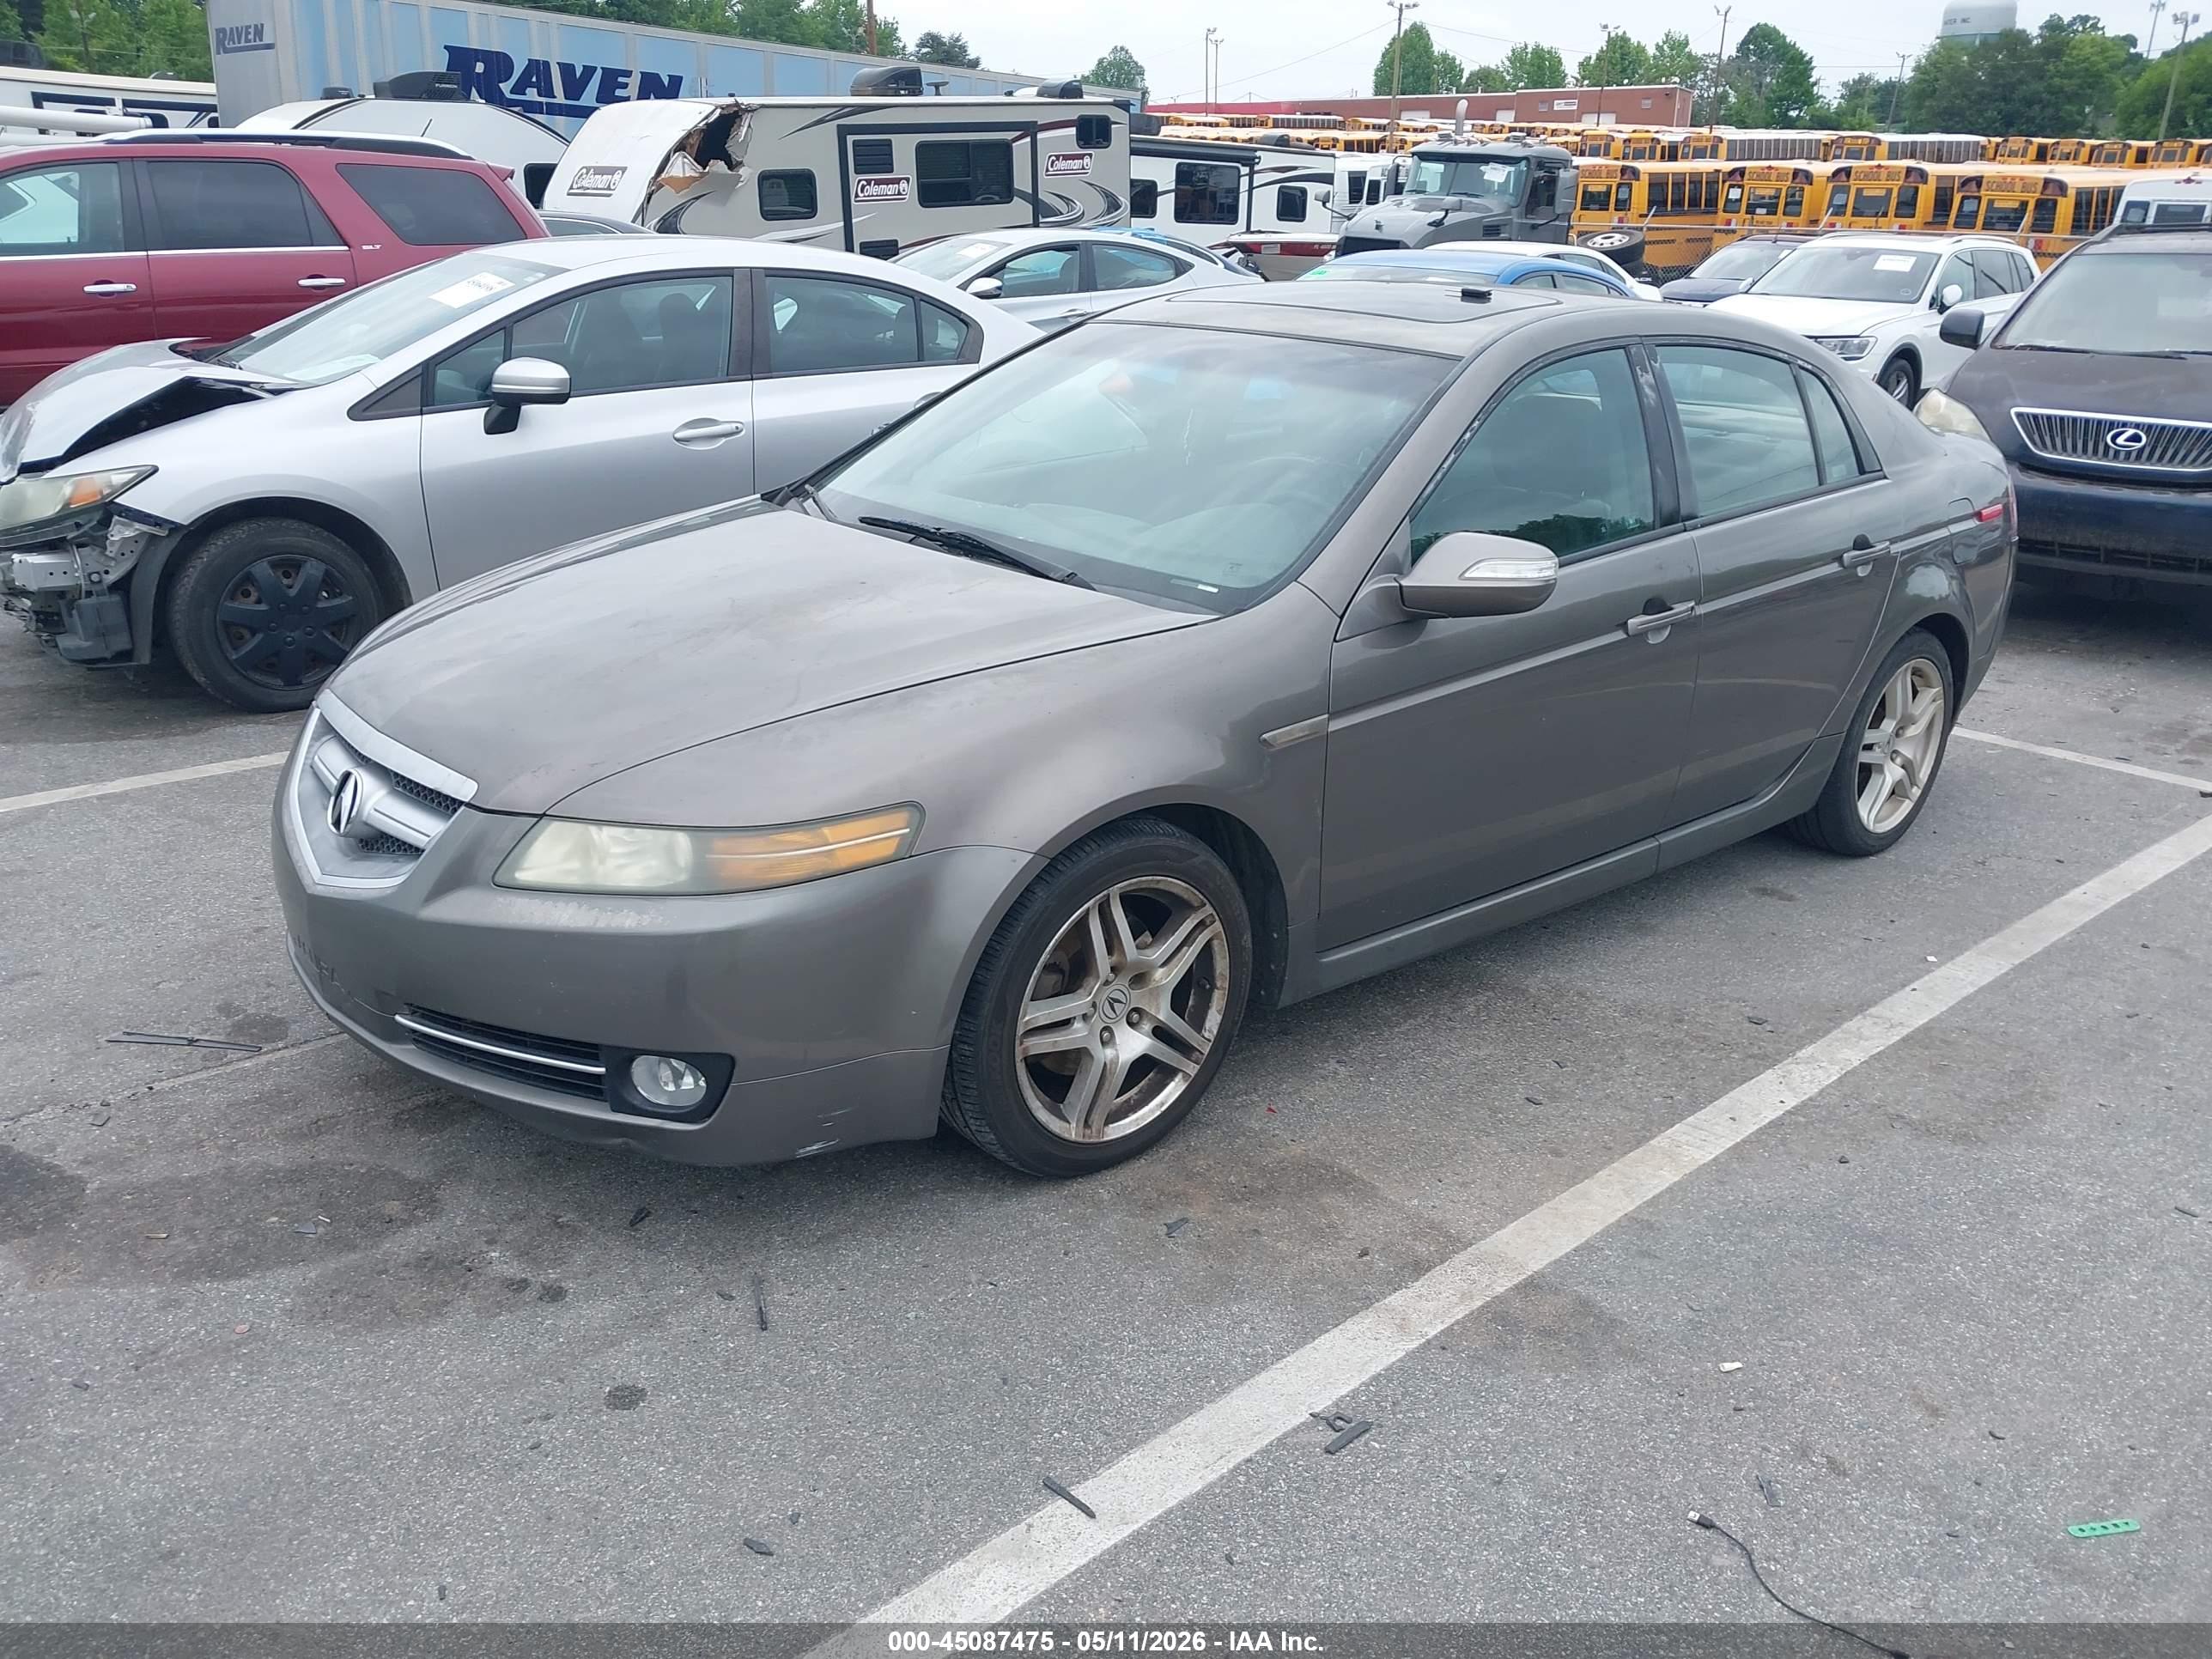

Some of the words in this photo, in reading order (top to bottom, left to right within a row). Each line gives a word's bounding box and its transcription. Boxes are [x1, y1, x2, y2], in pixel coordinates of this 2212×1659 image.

[215, 22, 264, 55] RAVEN
[443, 45, 684, 108] RAVEN
[1048, 155, 1083, 171] Coleman
[573, 167, 613, 189] Coleman
[1747, 171, 1772, 181] SCHOOL
[1777, 172, 1789, 182] BUS
[1854, 170, 1881, 181] SCHOOL
[1886, 171, 1901, 181] BUS
[857, 179, 899, 197] Coleman
[1986, 180, 2015, 192] SCHOOL
[2021, 181, 2039, 193] BUS
